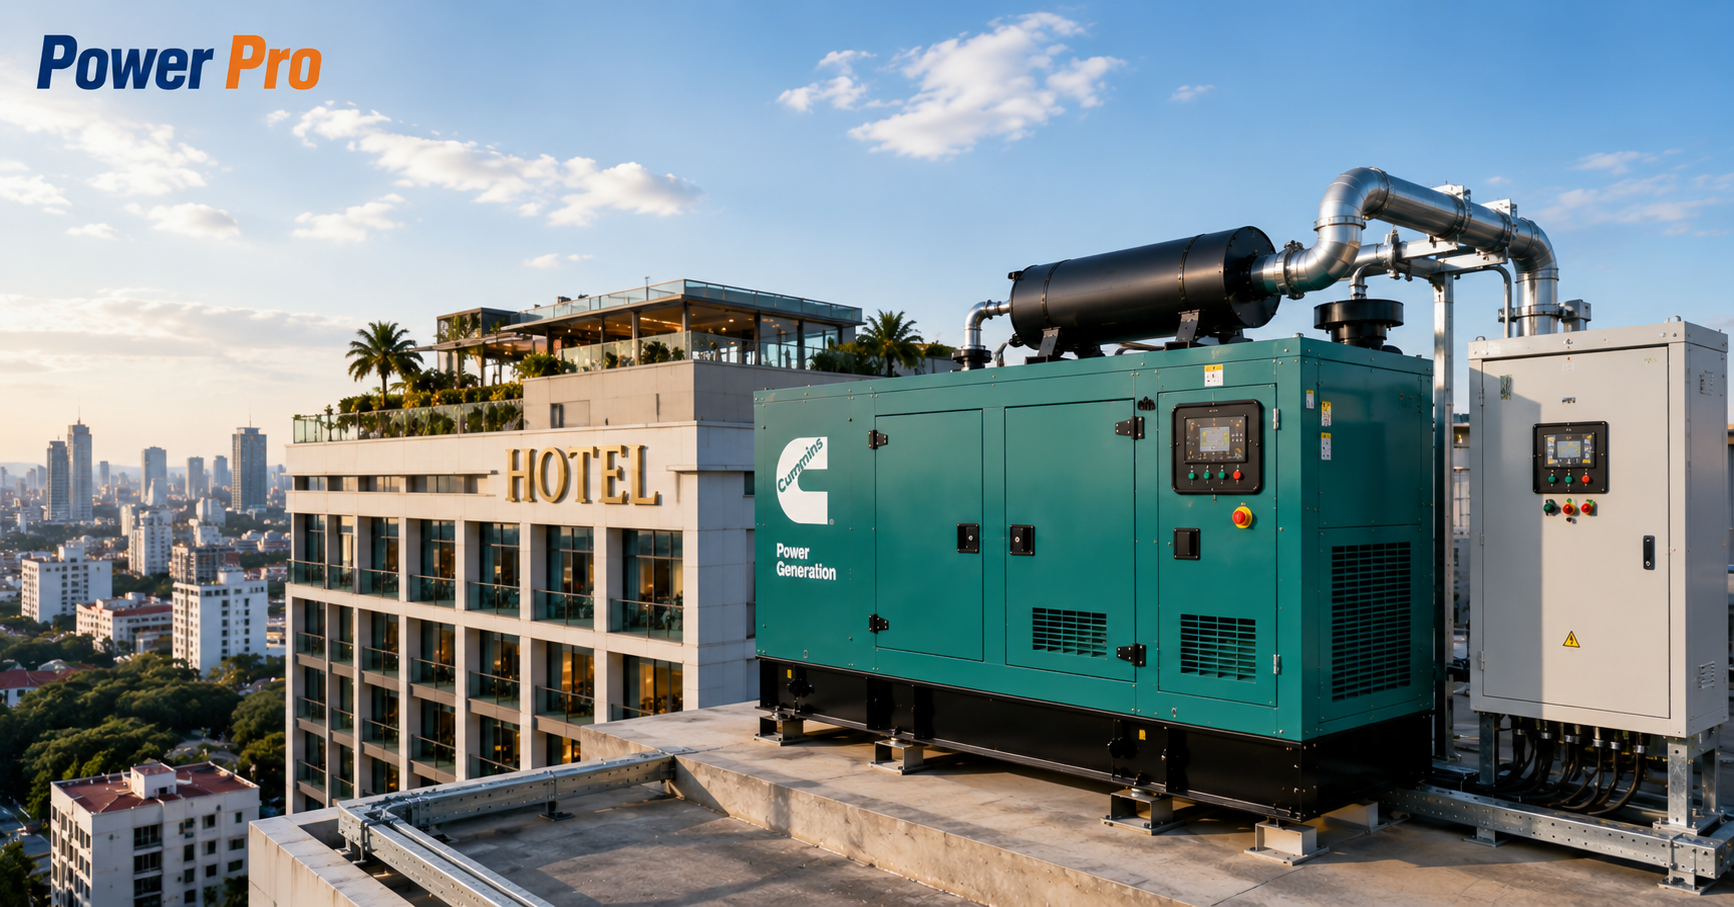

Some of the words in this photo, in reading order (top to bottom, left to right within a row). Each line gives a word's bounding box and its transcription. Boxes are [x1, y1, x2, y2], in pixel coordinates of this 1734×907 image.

[505, 444, 662, 506] HOTEL
[777, 437, 824, 493] Cummins
[776, 542, 810, 560] Power
[776, 560, 837, 581] Generation
